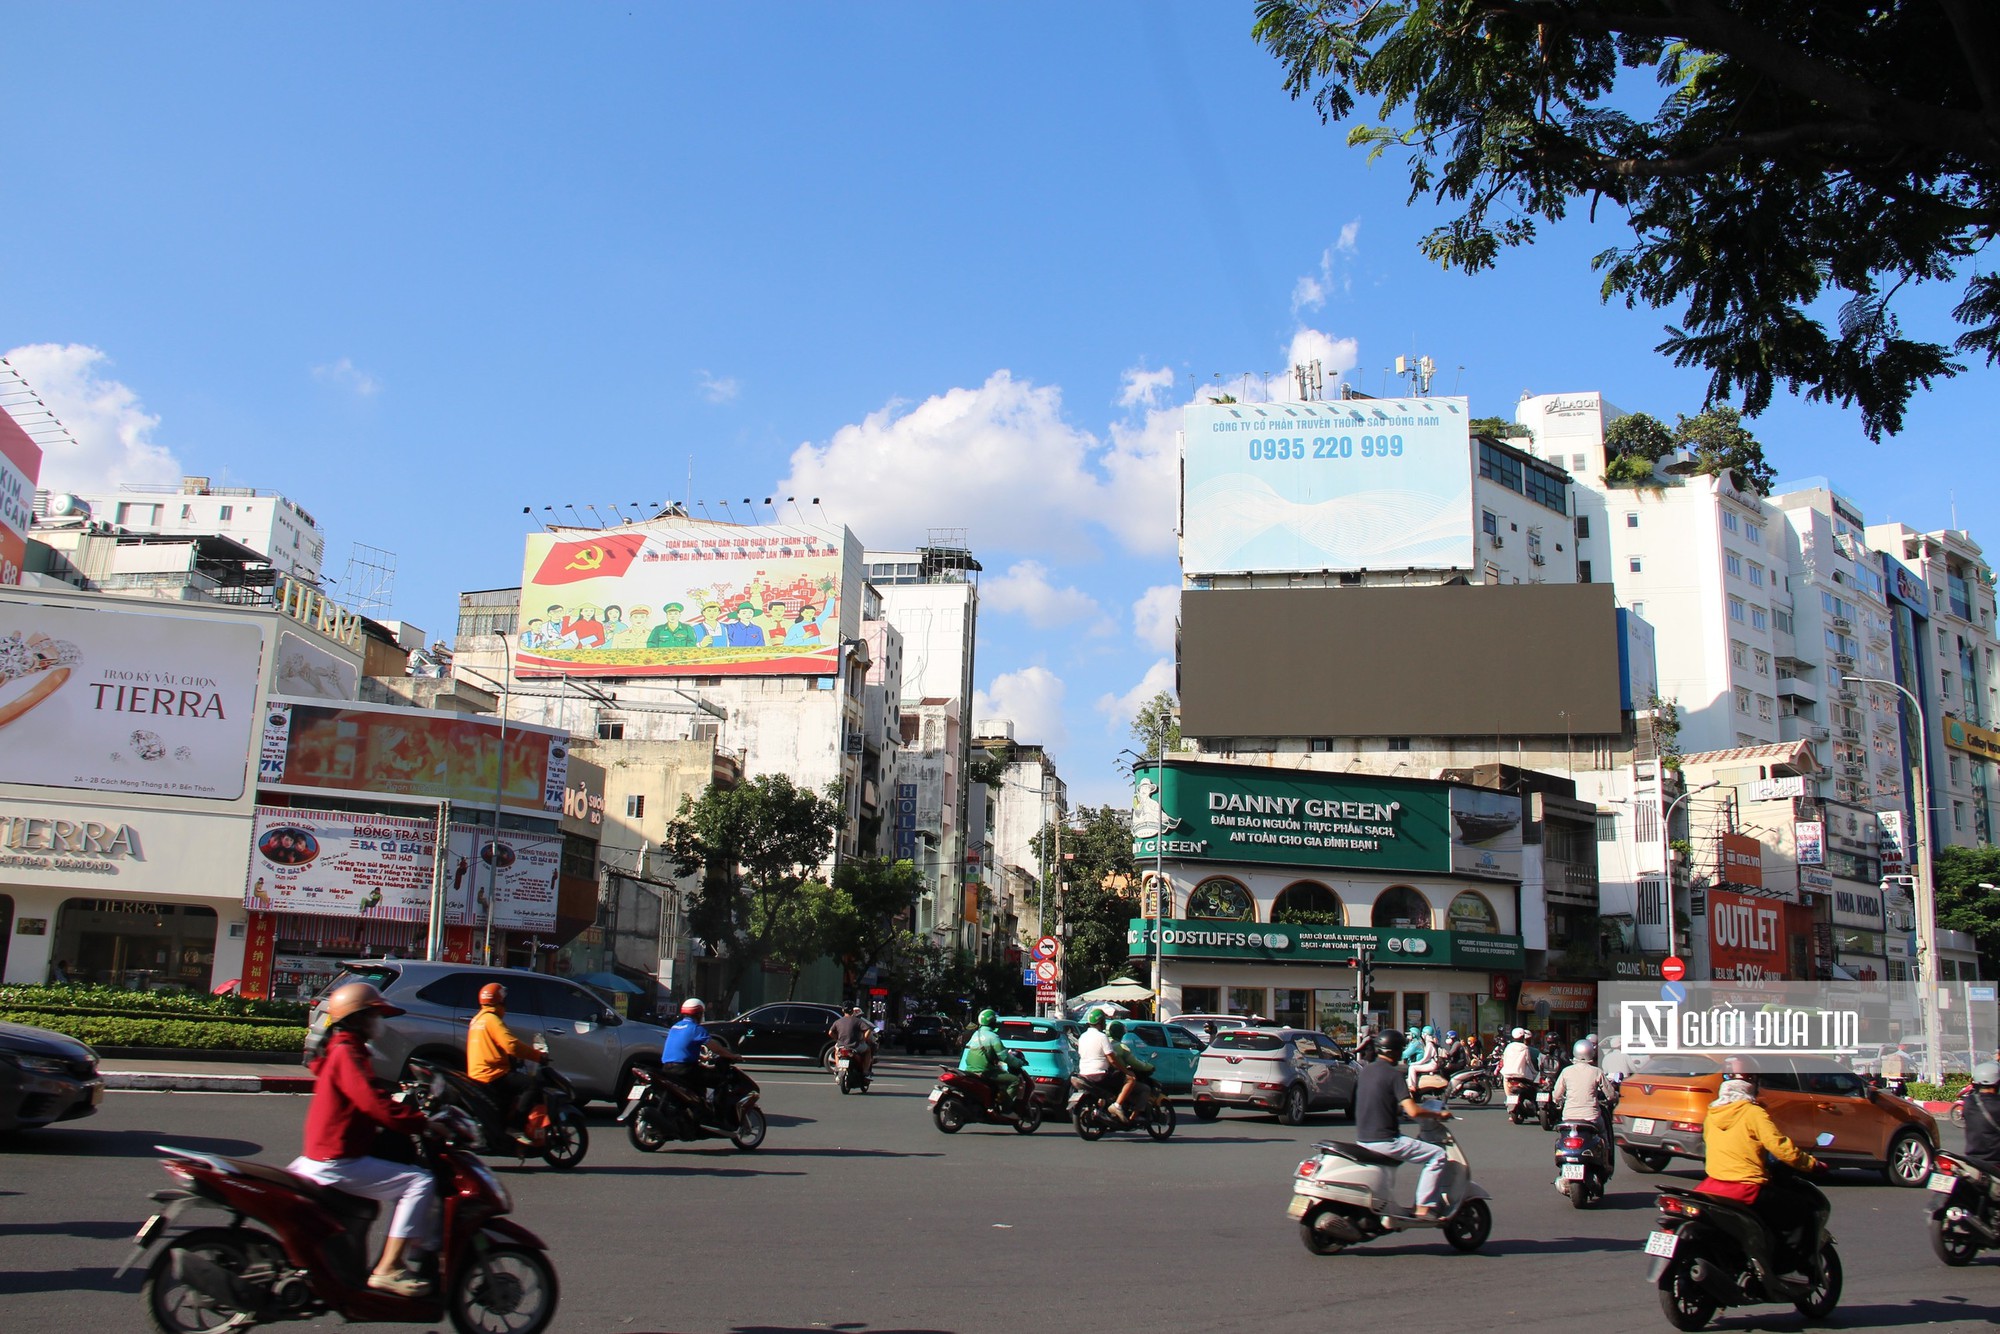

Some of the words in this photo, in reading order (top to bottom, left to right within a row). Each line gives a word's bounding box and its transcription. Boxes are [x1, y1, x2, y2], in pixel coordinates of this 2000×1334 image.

[1213, 421, 1237, 432] CÔNG
[1240, 421, 1251, 431] TY
[1253, 417, 1266, 431] CỔ
[1269, 417, 1293, 430] PHẦN
[1296, 416, 1330, 430] TRUYỀN
[1334, 418, 1364, 428] THÔNG
[1367, 417, 1385, 427] SAO
[1417, 416, 1439, 426] NAM
[1249, 437, 1305, 460] 0935
[1313, 435, 1352, 459] 220
[1361, 434, 1403, 457] 999
[665, 540, 680, 549] TOÀN
[701, 538, 718, 548] TOÀN
[733, 537, 749, 548] TOÀN
[750, 537, 767, 548] QUÂN
[780, 535, 801, 546] THÀNH
[802, 535, 817, 545] TÍCH
[643, 552, 659, 562] CHÀO
[730, 550, 747, 561] TOÀN
[748, 549, 764, 561] QUỐC
[793, 548, 804, 559] XIV
[279, 571, 361, 652] TIERRA
[104, 669, 134, 681] TRAO
[181, 675, 217, 689] CHỌN
[90, 683, 226, 720] TIERRA
[261, 759, 284, 773] 7K
[100, 776, 119, 786] Cách
[141, 779, 162, 790] Tháng
[546, 789, 564, 803] 7K
[1208, 791, 1300, 815] DANNY
[1304, 799, 1393, 822] GREEN
[353, 824, 391, 838] HỒNG
[394, 828, 420, 840] TRÀ
[1211, 813, 1236, 826] ĐẢM
[1238, 815, 1261, 828] BẢO
[1263, 817, 1300, 830] NGUỒN
[1303, 820, 1332, 834] THỰC
[1333, 820, 1363, 834] PHẨM
[1364, 825, 1395, 838] SẠCH,
[0, 815, 135, 856] IERRA
[1230, 832, 1245, 842] AN
[1247, 832, 1277, 844] TOÀN
[1278, 836, 1302, 845] CHO
[1304, 837, 1322, 847] GIA
[1323, 838, 1349, 848] ĐÌNH
[1350, 840, 1372, 851] BẠN
[1144, 840, 1202, 853] GREEN
[54, 858, 112, 871] DIAMOND
[1836, 891, 1855, 913] NHA
[1856, 894, 1880, 917] KHOA
[1714, 902, 1777, 951] OUTLET
[1141, 929, 1246, 947] FOODSTUFFS
[1616, 961, 1640, 975] CRANE
[1646, 963, 1661, 976] TEA
[1715, 967, 1726, 979] DEAL
[1736, 963, 1765, 989] 50%
